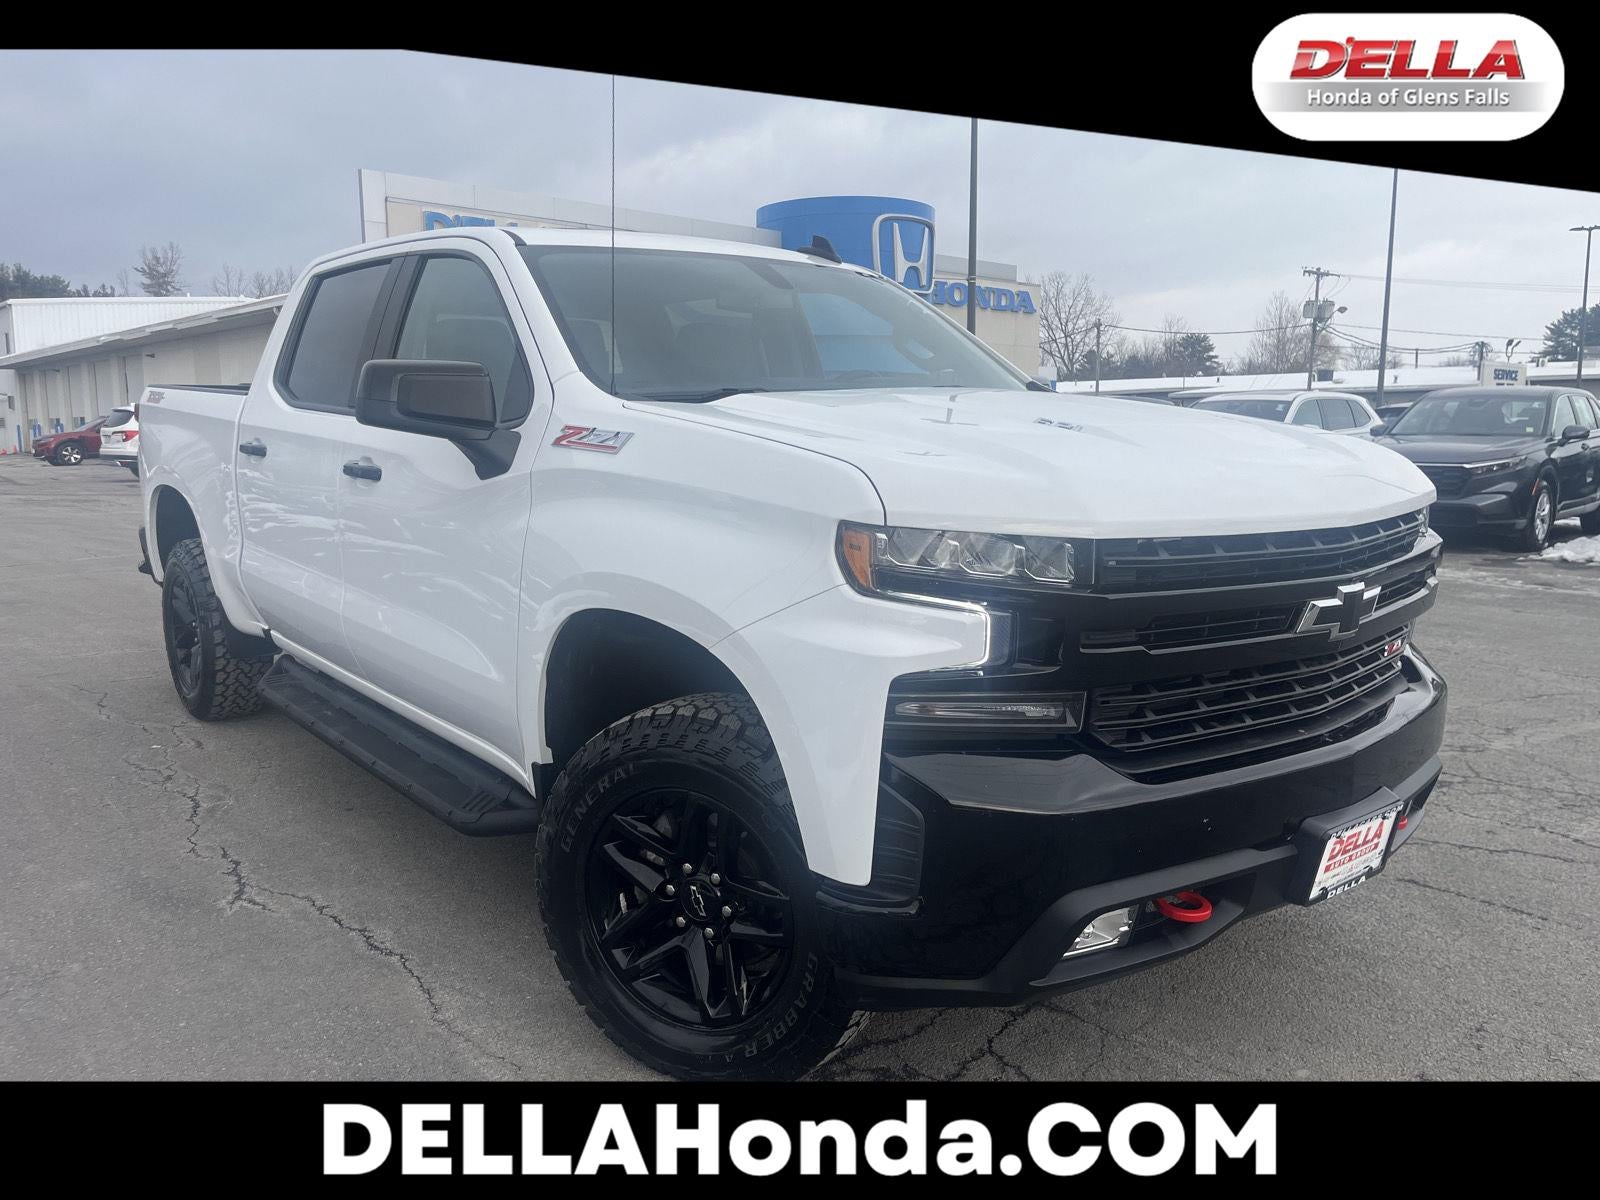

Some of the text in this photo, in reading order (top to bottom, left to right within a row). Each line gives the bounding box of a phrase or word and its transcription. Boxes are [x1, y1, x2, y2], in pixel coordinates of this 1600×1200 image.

[1493, 368, 1518, 381] SERVICE
[551, 424, 634, 455] Z71
[562, 764, 638, 852] GENERAL
[1328, 820, 1385, 862] DELLA
[1327, 876, 1366, 899] DELLA
[746, 955, 818, 1059] GRABBER
